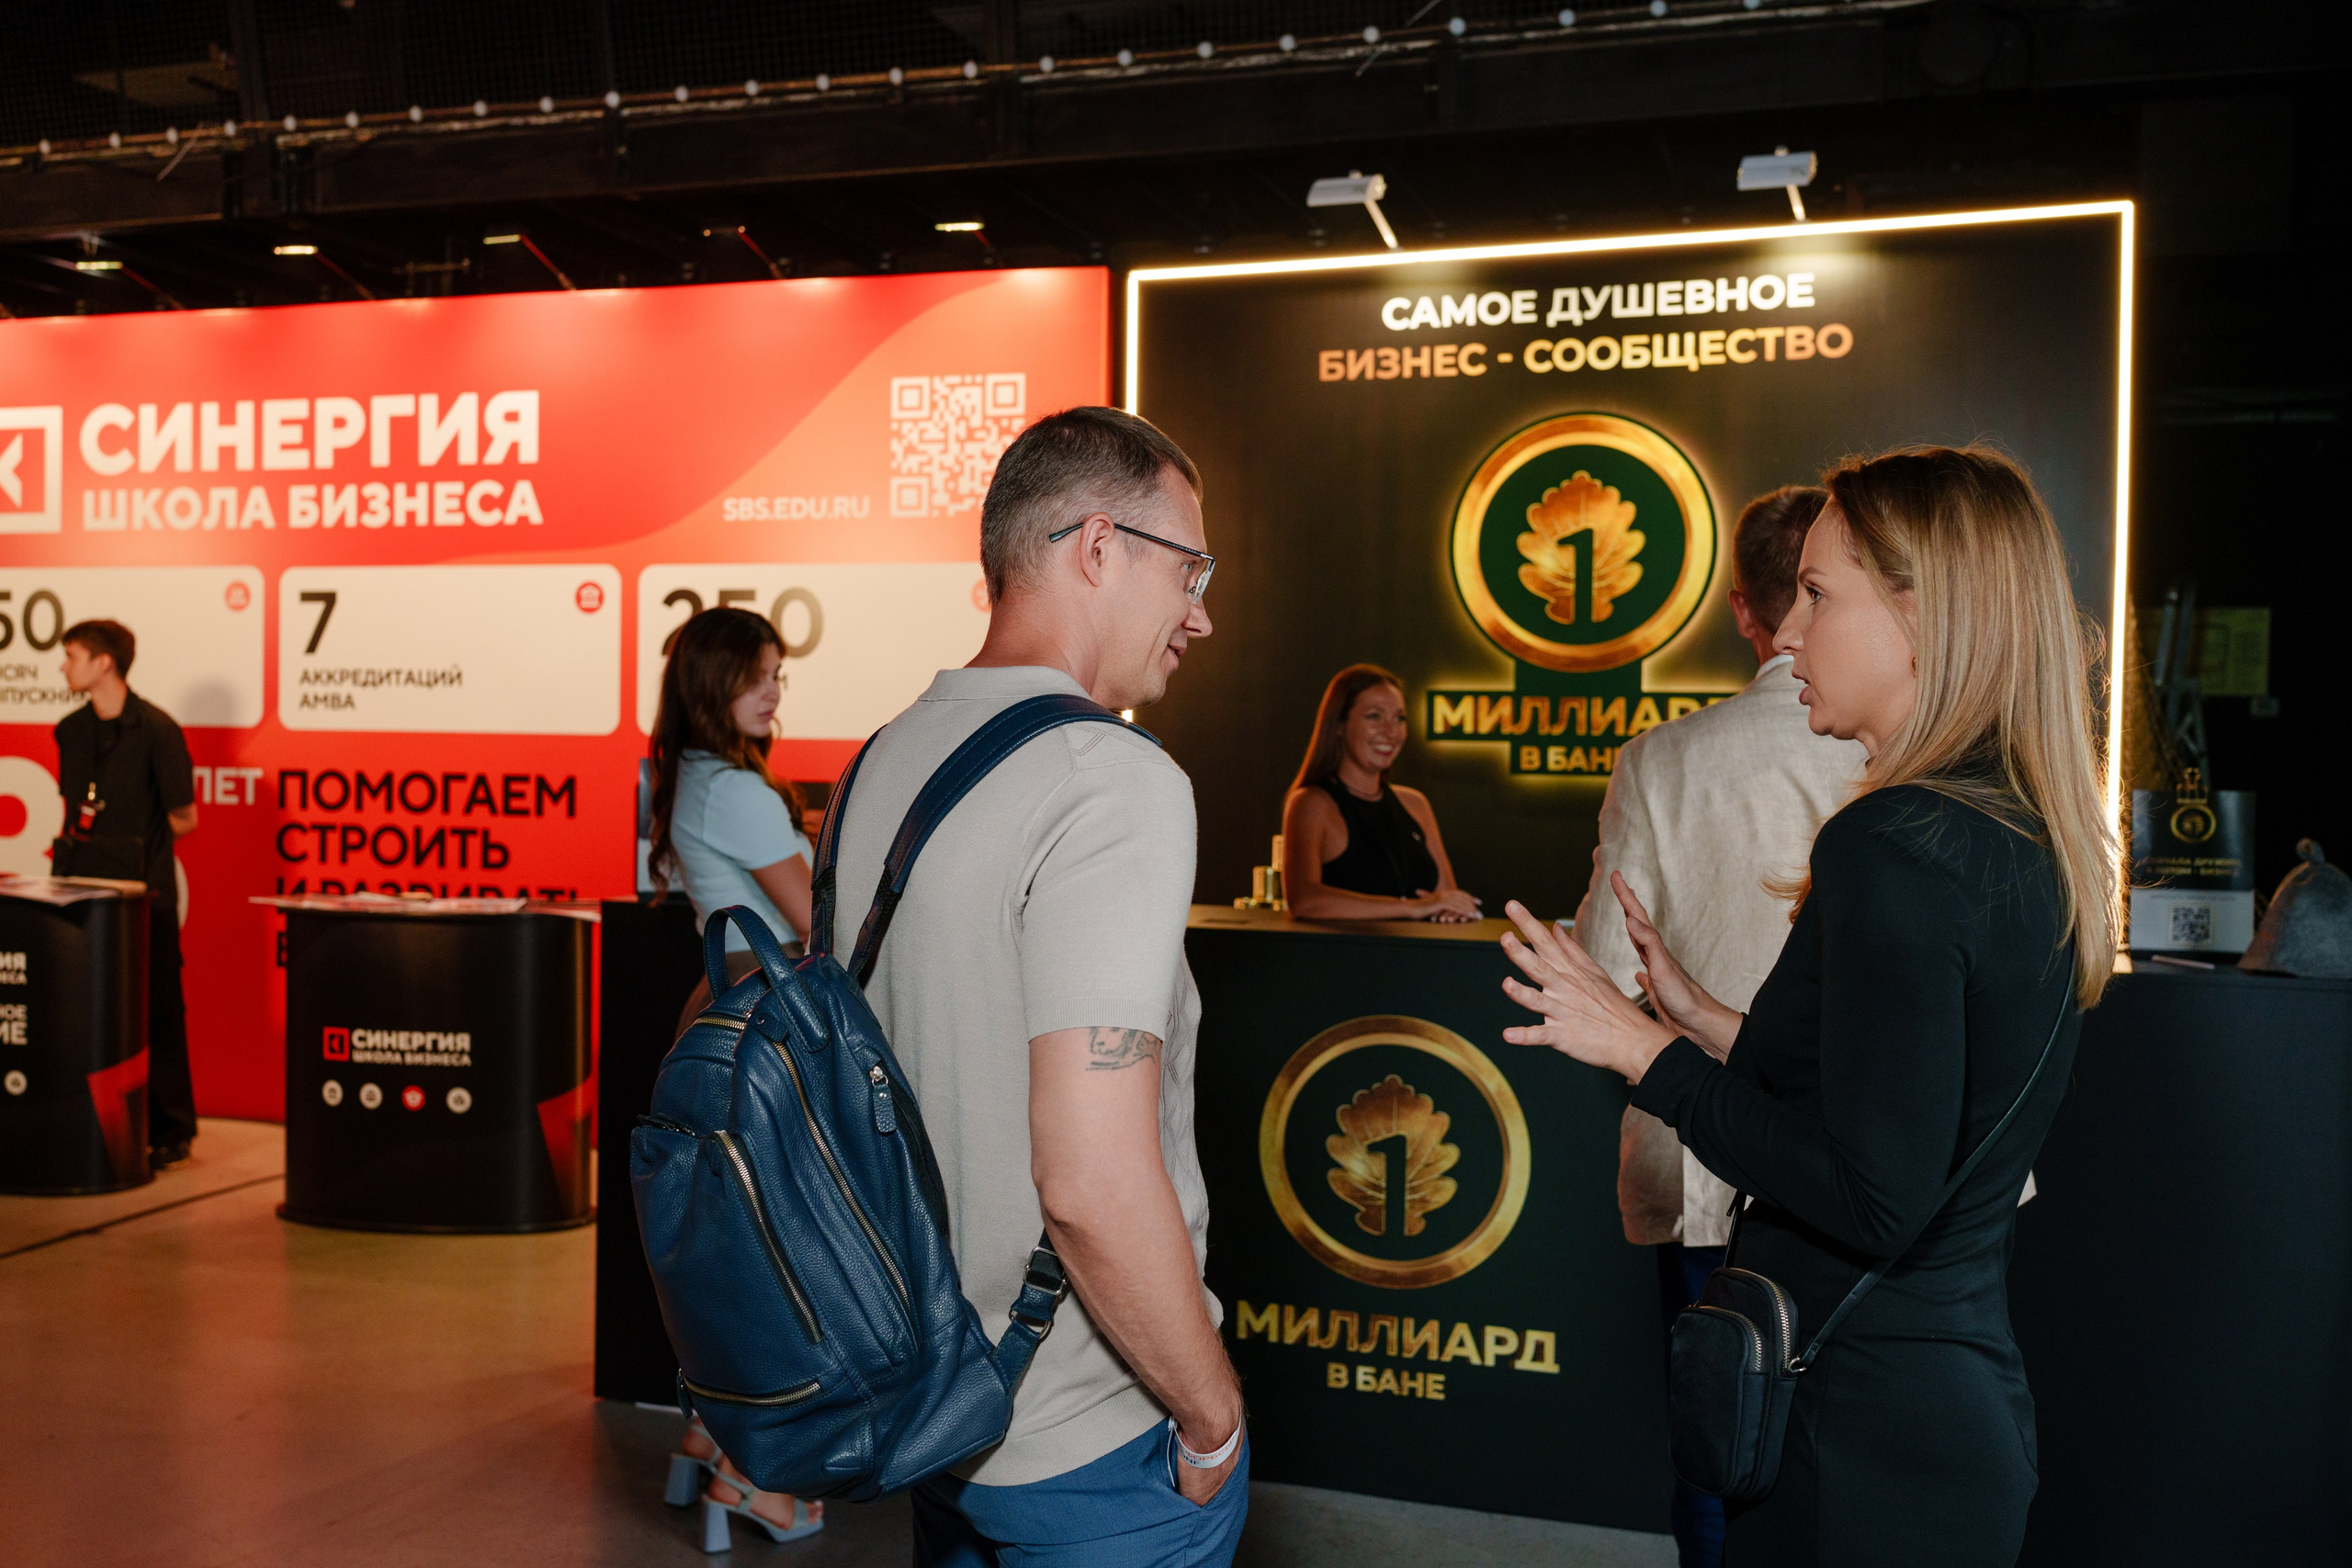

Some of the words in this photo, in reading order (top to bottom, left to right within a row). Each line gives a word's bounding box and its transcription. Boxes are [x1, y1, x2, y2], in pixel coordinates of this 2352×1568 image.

[1381, 290, 1538, 331] САМОЕ
[1546, 272, 1816, 327] ДУШЕВНОЕ
[1317, 343, 1487, 382] БИЗНЕС
[1523, 323, 1854, 374] СООБЩЕСТВО
[79, 389, 540, 476] СИНЕРГИЯ
[83, 486, 276, 531] ШКОЛА
[288, 479, 544, 528] БИЗНЕСА
[722, 495, 870, 522] SBS.EDU.RU
[300, 591, 337, 654] 7
[662, 587, 824, 659] 20
[300, 664, 462, 690] АККРЕДИТАЦИЙ
[1432, 694, 1730, 737] МИЛЛИАР
[1520, 745, 1542, 772] В
[1546, 744, 1621, 773] БАН
[278, 770, 576, 818] ПОМОГАЕМ
[277, 823, 510, 870] СТРОИТЬ
[351, 1028, 471, 1053] СИНЕРГИЯ
[352, 1050, 402, 1066] ШКОЛА
[404, 1052, 472, 1067] БИЗНЕСА
[1237, 1299, 1560, 1374] МИЛЛИАРД
[1327, 1362, 1349, 1389] В
[1355, 1366, 1446, 1401] БАНЕ
